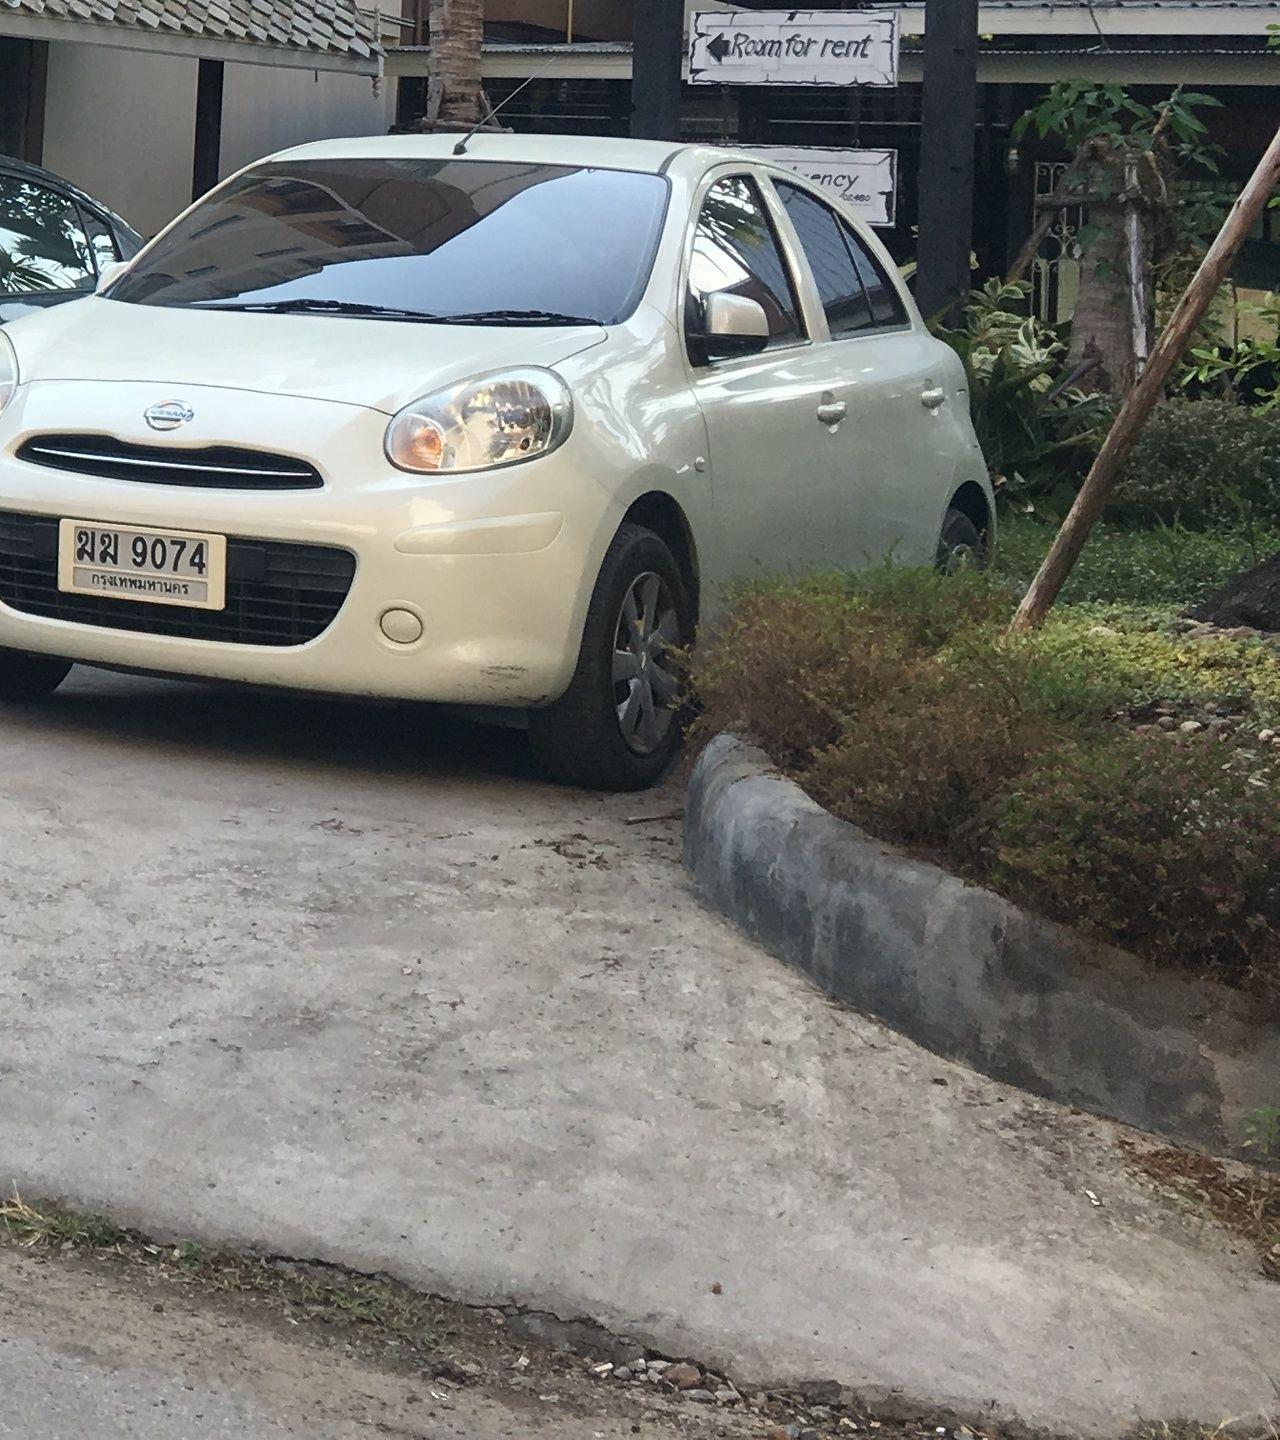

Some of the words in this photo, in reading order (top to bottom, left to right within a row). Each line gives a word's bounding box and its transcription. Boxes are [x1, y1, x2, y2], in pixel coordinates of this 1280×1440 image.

[731, 32, 782, 59] Room
[785, 33, 819, 57] for
[820, 33, 874, 59] rent
[131, 536, 206, 575] 9074
[91, 572, 190, 595] กรุงเทพมหานคร
